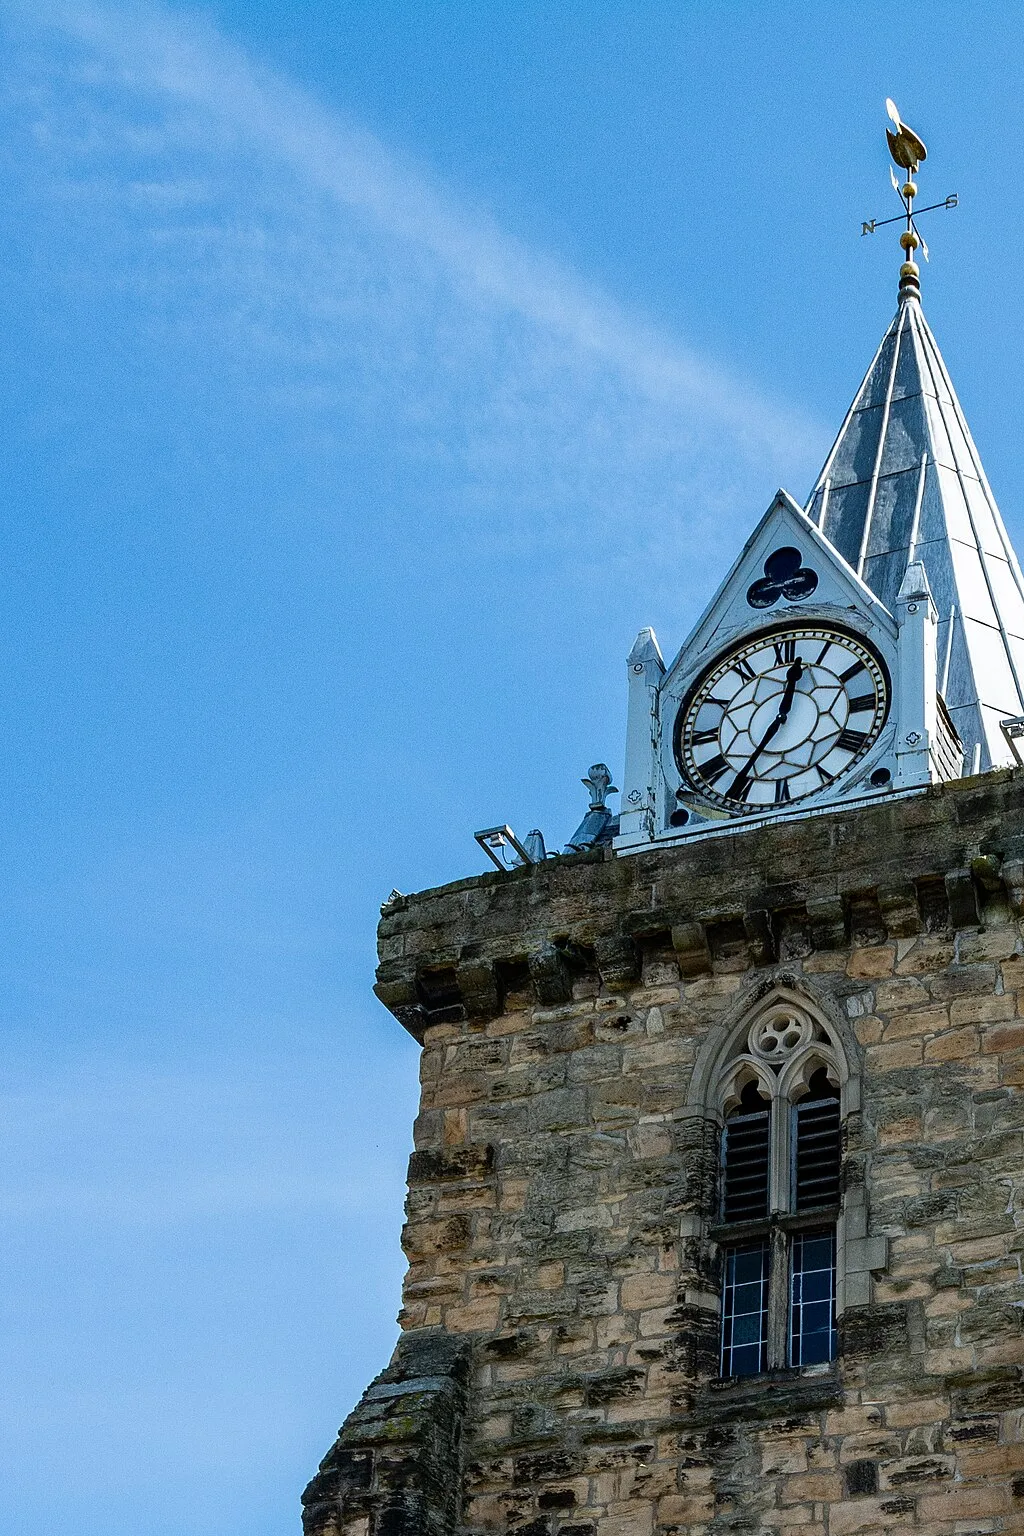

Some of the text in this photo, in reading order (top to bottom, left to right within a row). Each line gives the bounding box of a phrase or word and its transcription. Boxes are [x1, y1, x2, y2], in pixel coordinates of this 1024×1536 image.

[945, 193, 959, 210] S
[861, 218, 876, 237] N
[773, 640, 796, 668] XII
[815, 640, 832, 665] I
[731, 658, 757, 685] XI
[848, 692, 876, 713] III
[692, 726, 719, 746] IX
